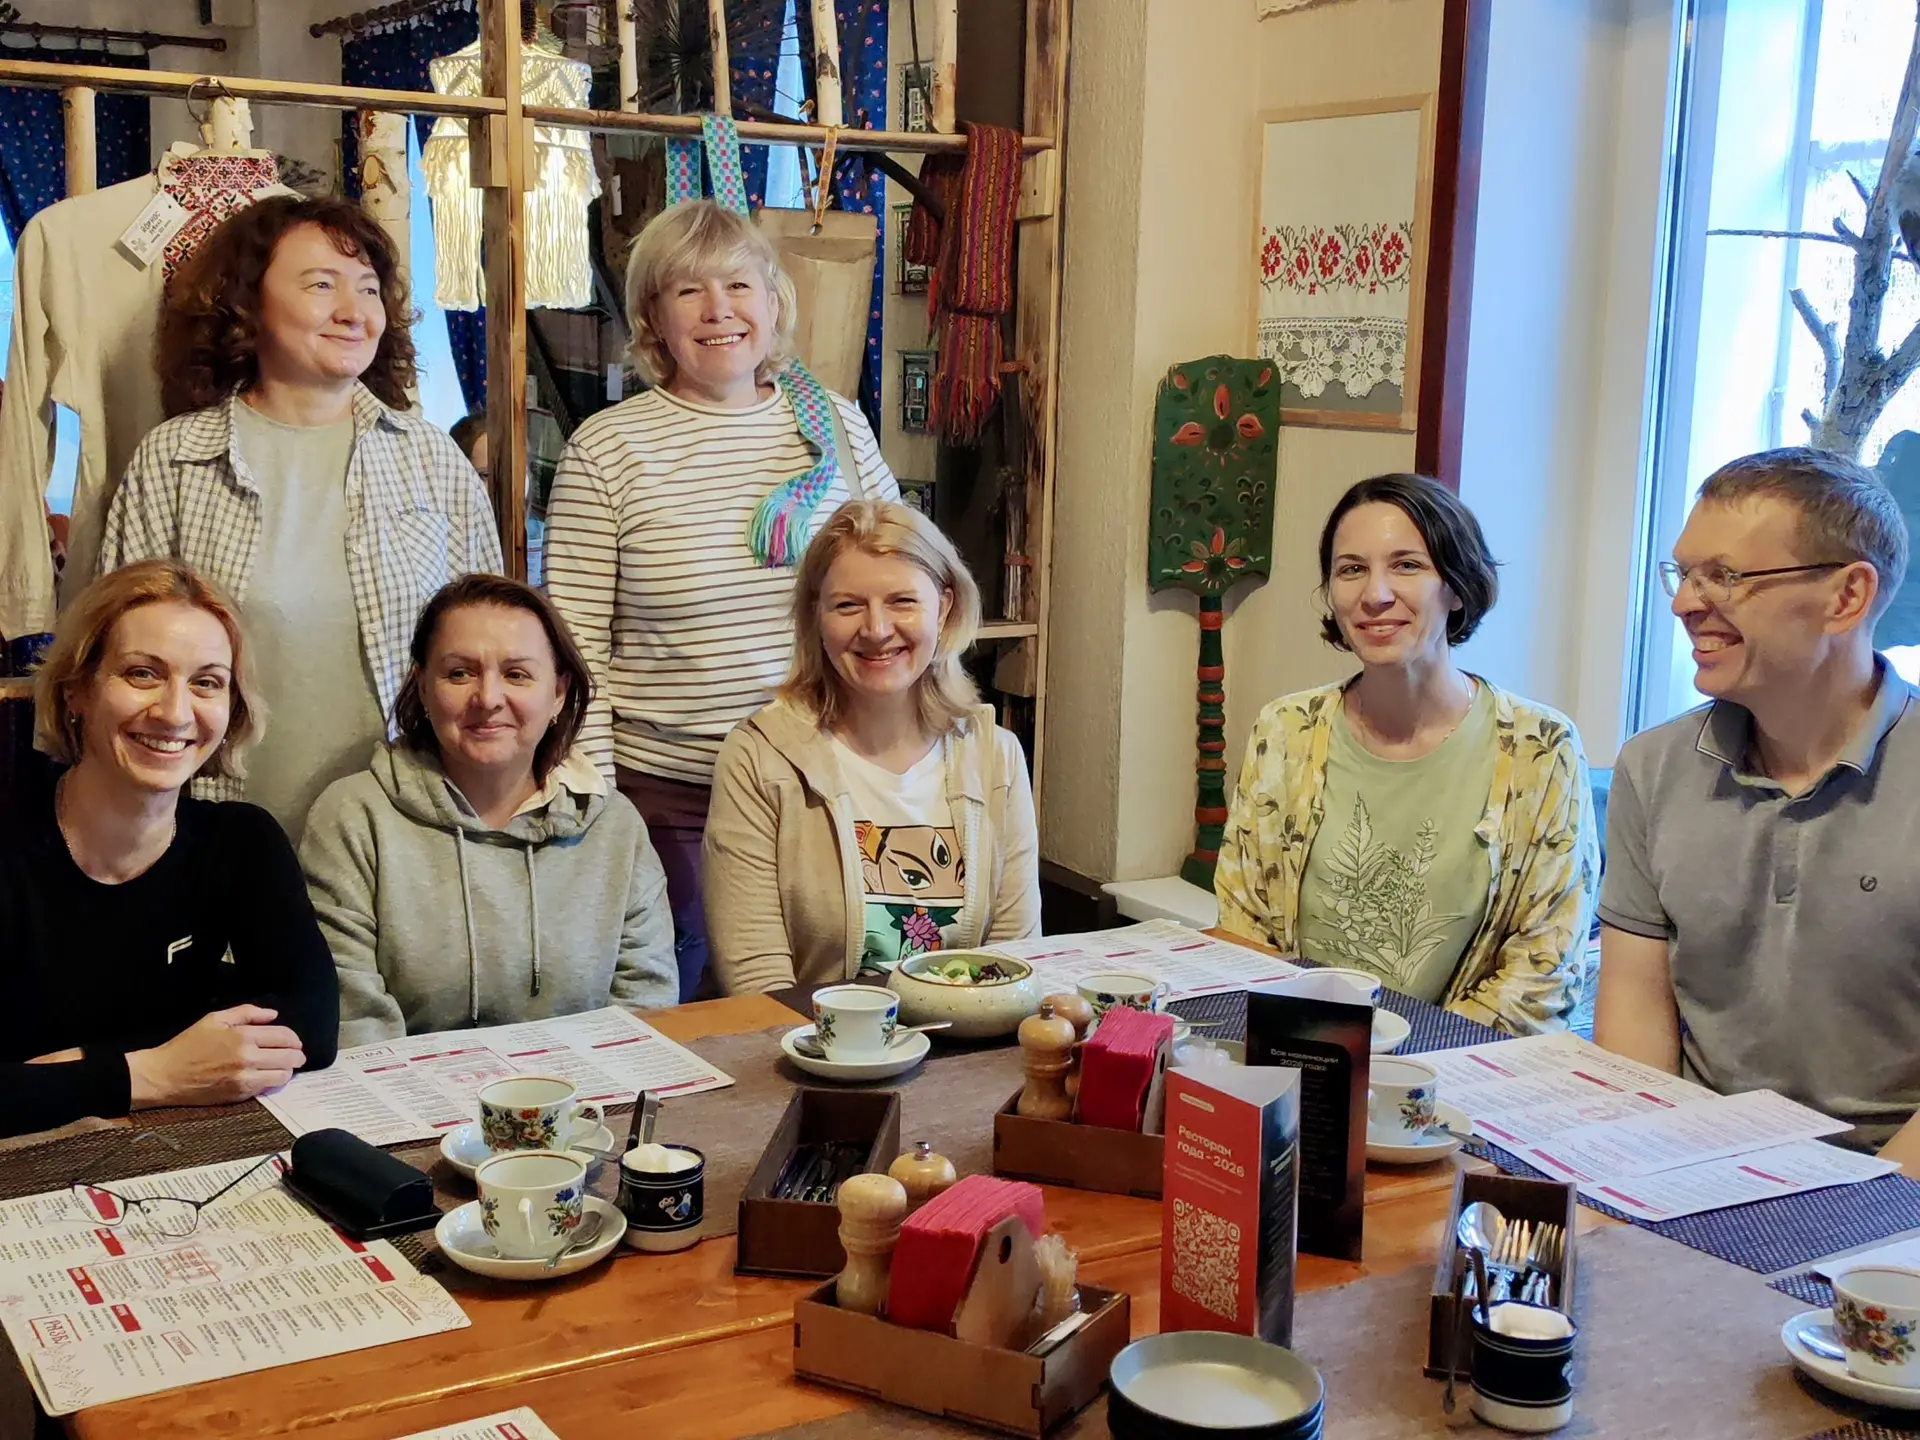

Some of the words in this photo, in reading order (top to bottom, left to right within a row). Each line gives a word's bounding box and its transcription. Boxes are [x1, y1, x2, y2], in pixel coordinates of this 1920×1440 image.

[1178, 1124, 1232, 1158] Ресторан
[1177, 1141, 1204, 1160] года
[1213, 1155, 1245, 1178] 2026
